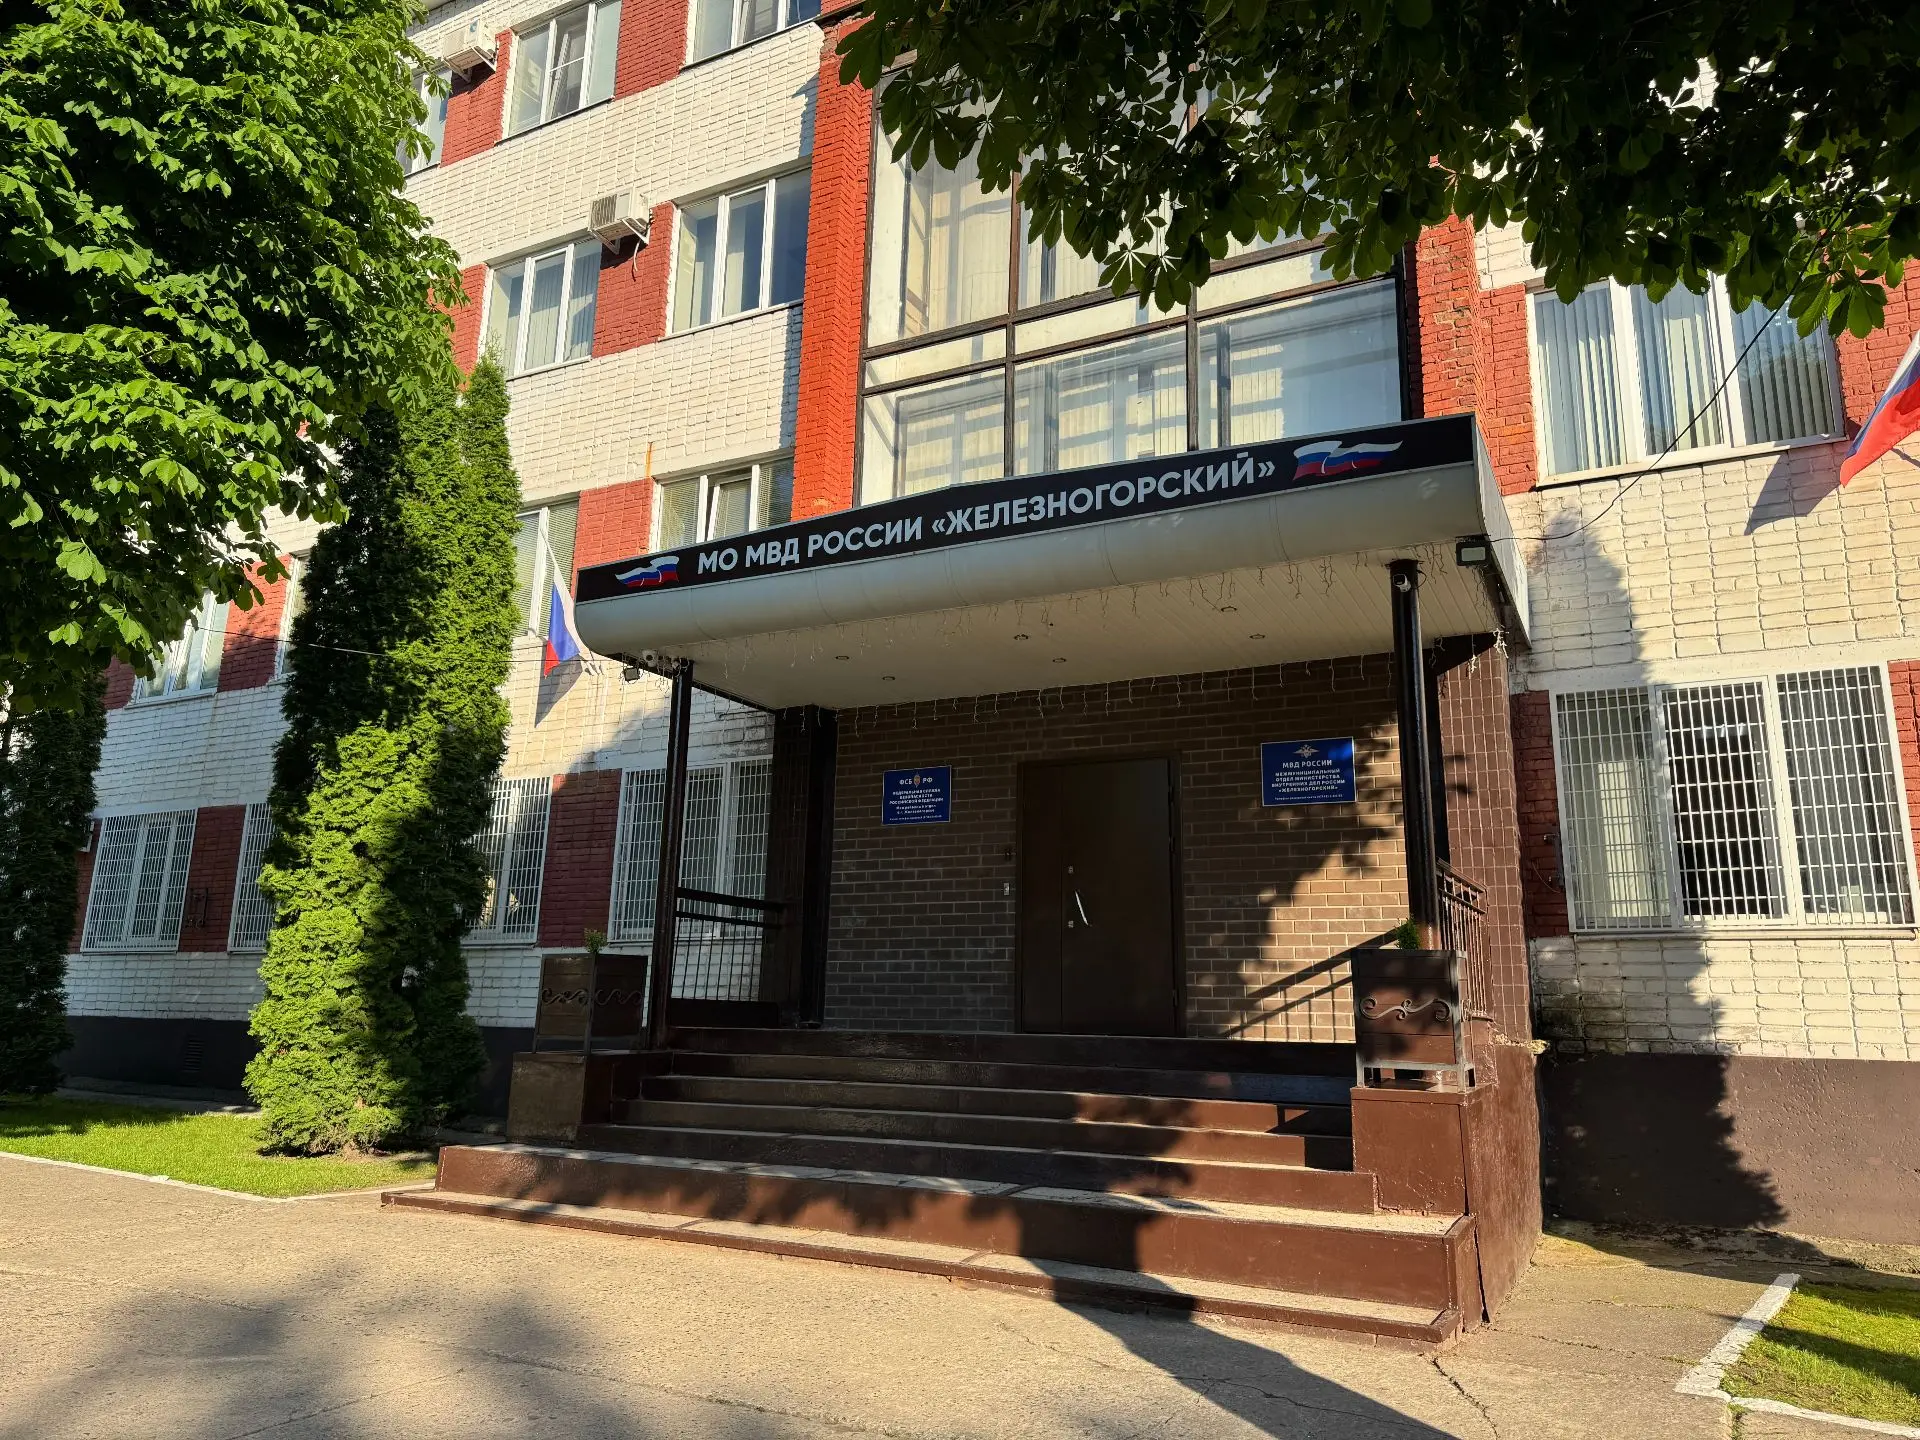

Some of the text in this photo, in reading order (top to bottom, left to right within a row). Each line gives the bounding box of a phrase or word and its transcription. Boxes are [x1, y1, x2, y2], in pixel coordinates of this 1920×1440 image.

[697, 451, 1276, 574] МО МВД РОССИИ «ЖЕЛЕЗНОГОРСКИЙ»
[1282, 759, 1332, 769] МВД РОССИИ
[922, 776, 933, 784] РФ
